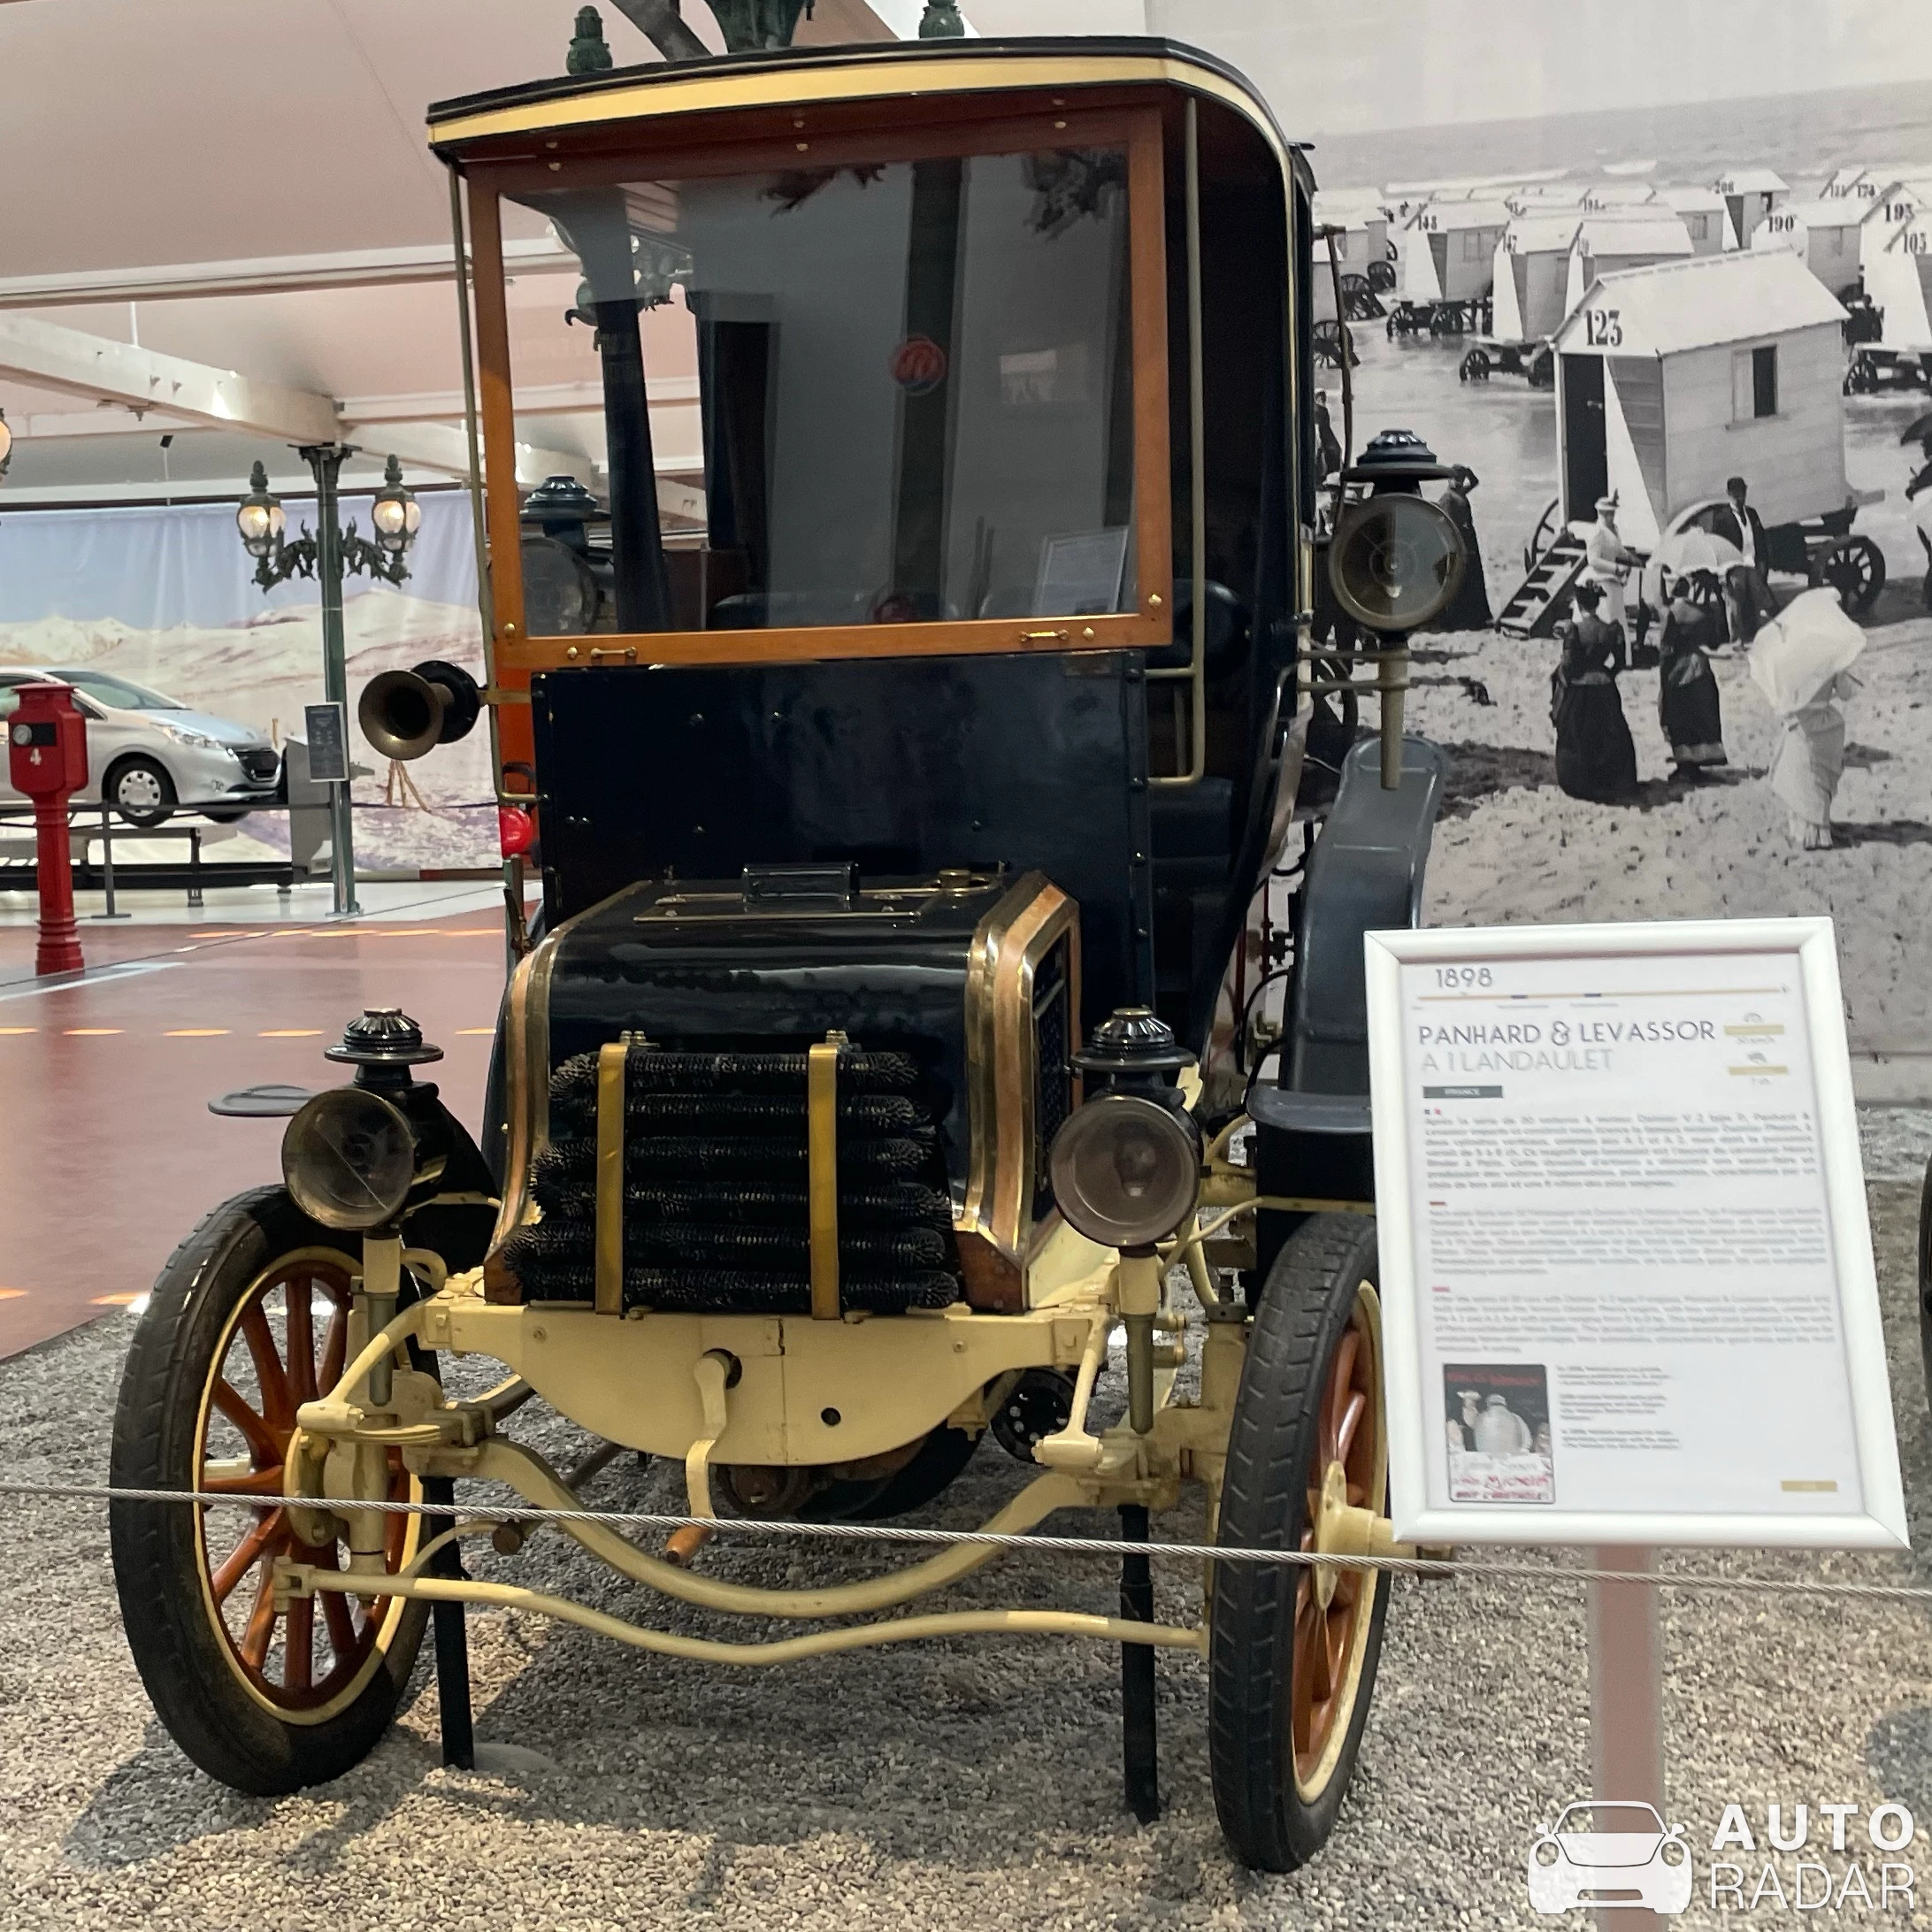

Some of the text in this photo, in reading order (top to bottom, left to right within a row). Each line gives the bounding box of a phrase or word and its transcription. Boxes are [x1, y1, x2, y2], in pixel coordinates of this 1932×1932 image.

[1769, 215, 1794, 233] 190
[1586, 310, 1622, 347] 123
[30, 748, 42, 766] 4
[1436, 968, 1492, 987] 1898
[1419, 1024, 1541, 1045] PANHARD
[1551, 1021, 1571, 1046] &
[1579, 1020, 1715, 1043] LEVASSOR
[1460, 1049, 1613, 1072] LANDAULET
